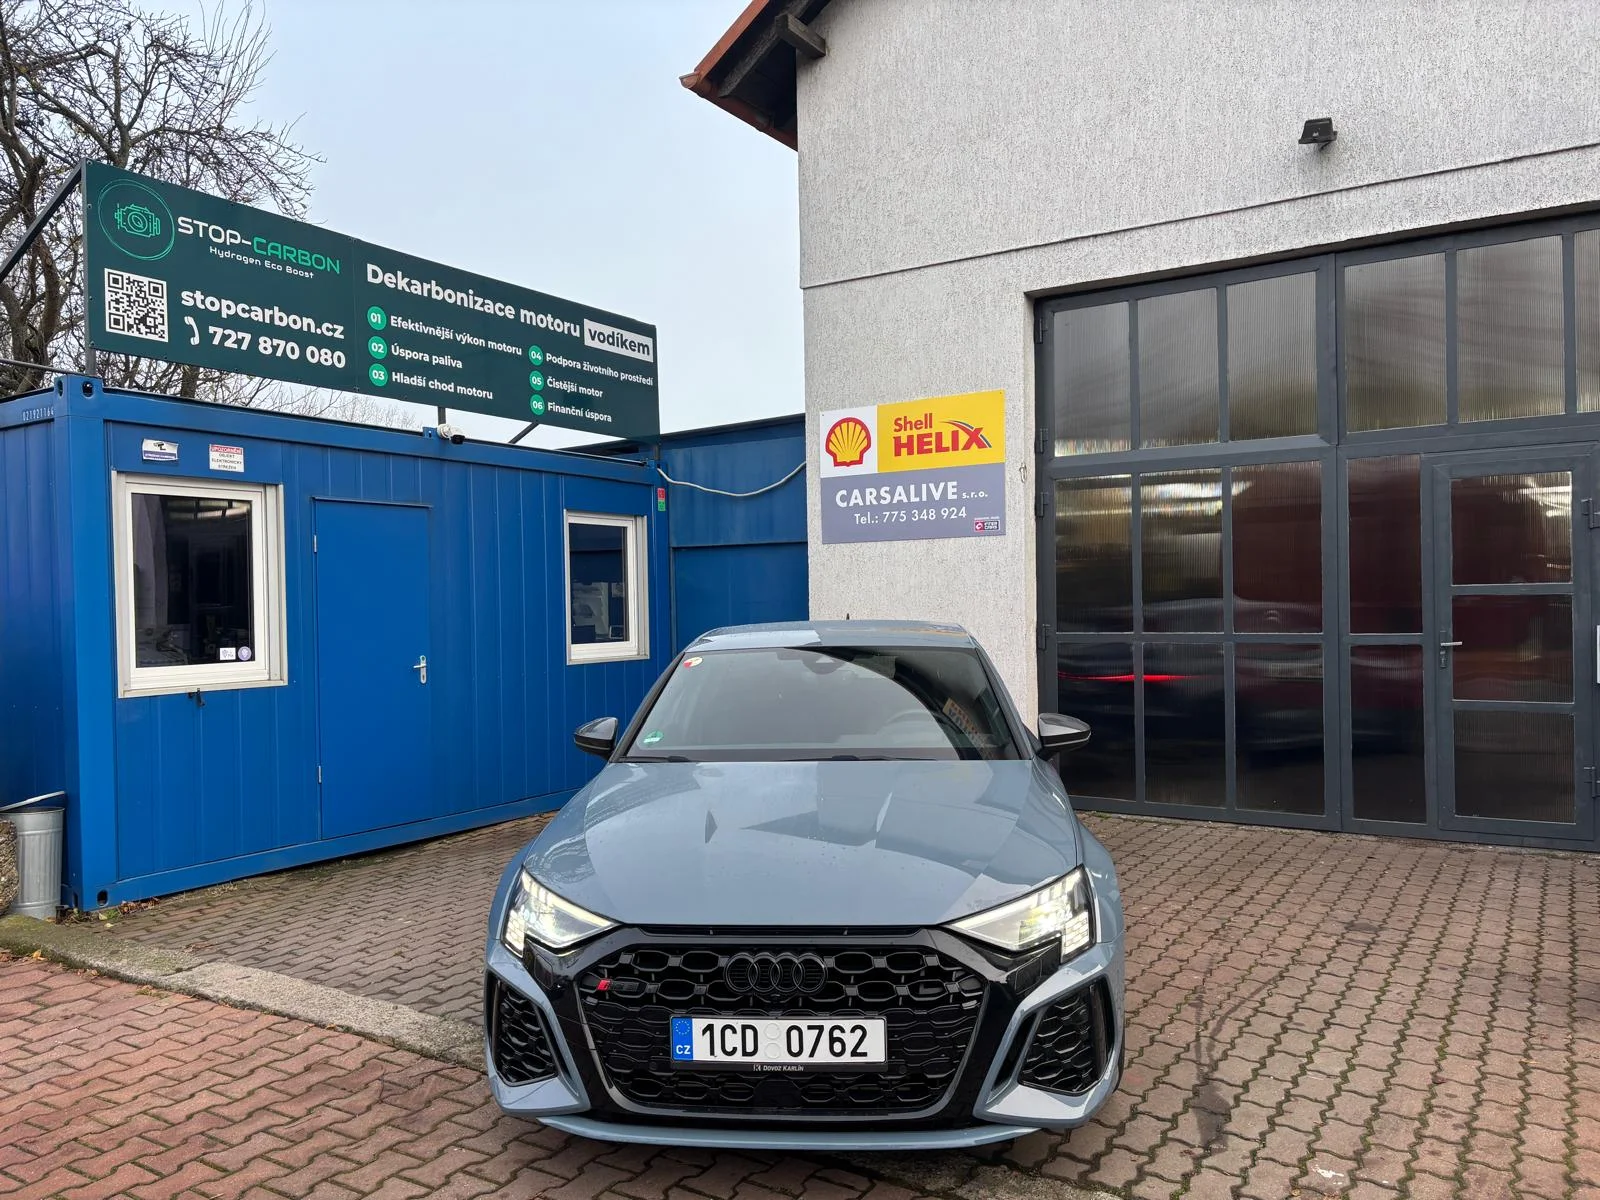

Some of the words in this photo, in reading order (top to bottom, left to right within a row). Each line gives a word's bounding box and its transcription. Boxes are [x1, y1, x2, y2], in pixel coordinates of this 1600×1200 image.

[177, 216, 340, 274] STOP-CARBON
[209, 245, 262, 267] Hydrogen
[264, 260, 283, 272] Eco
[285, 265, 315, 279] Boost
[181, 290, 345, 339] stopcarbon.cz
[366, 263, 516, 320] Dekarbonizace
[520, 308, 580, 338] motoru
[588, 327, 650, 356] vodíkem
[208, 326, 251, 350] 727
[258, 336, 300, 360] 870
[305, 345, 346, 369] 080
[370, 312, 381, 324] 01
[390, 315, 454, 341] Efektivnější
[455, 332, 486, 348] výkon
[487, 341, 522, 356] motoru
[371, 342, 384, 354] 02
[391, 343, 430, 363] Úspora
[432, 354, 463, 369] paliva
[531, 351, 542, 361] 04
[546, 352, 581, 370] Podpora
[583, 361, 619, 378] životního
[620, 372, 654, 386] prostředí
[372, 369, 385, 381] 03
[392, 372, 426, 388] Hladší
[428, 379, 455, 393] chod
[457, 385, 493, 400] motoru
[531, 376, 542, 386] 05
[547, 376, 577, 393] Čistější
[578, 386, 603, 398] motor
[532, 400, 543, 411] 06
[547, 402, 583, 417] Finanční
[585, 408, 612, 423] úspora
[893, 413, 933, 432] Shell
[893, 428, 991, 457] HELIX
[835, 481, 958, 508] CARSALIVE
[962, 491, 988, 499] s.r.o.
[854, 512, 879, 525] Tel.:
[882, 511, 907, 523] 775
[911, 508, 936, 521] 348
[941, 506, 967, 519] 924
[675, 1044, 691, 1055] CZ
[701, 1023, 759, 1057] 1CD
[786, 1024, 868, 1058] 0762
